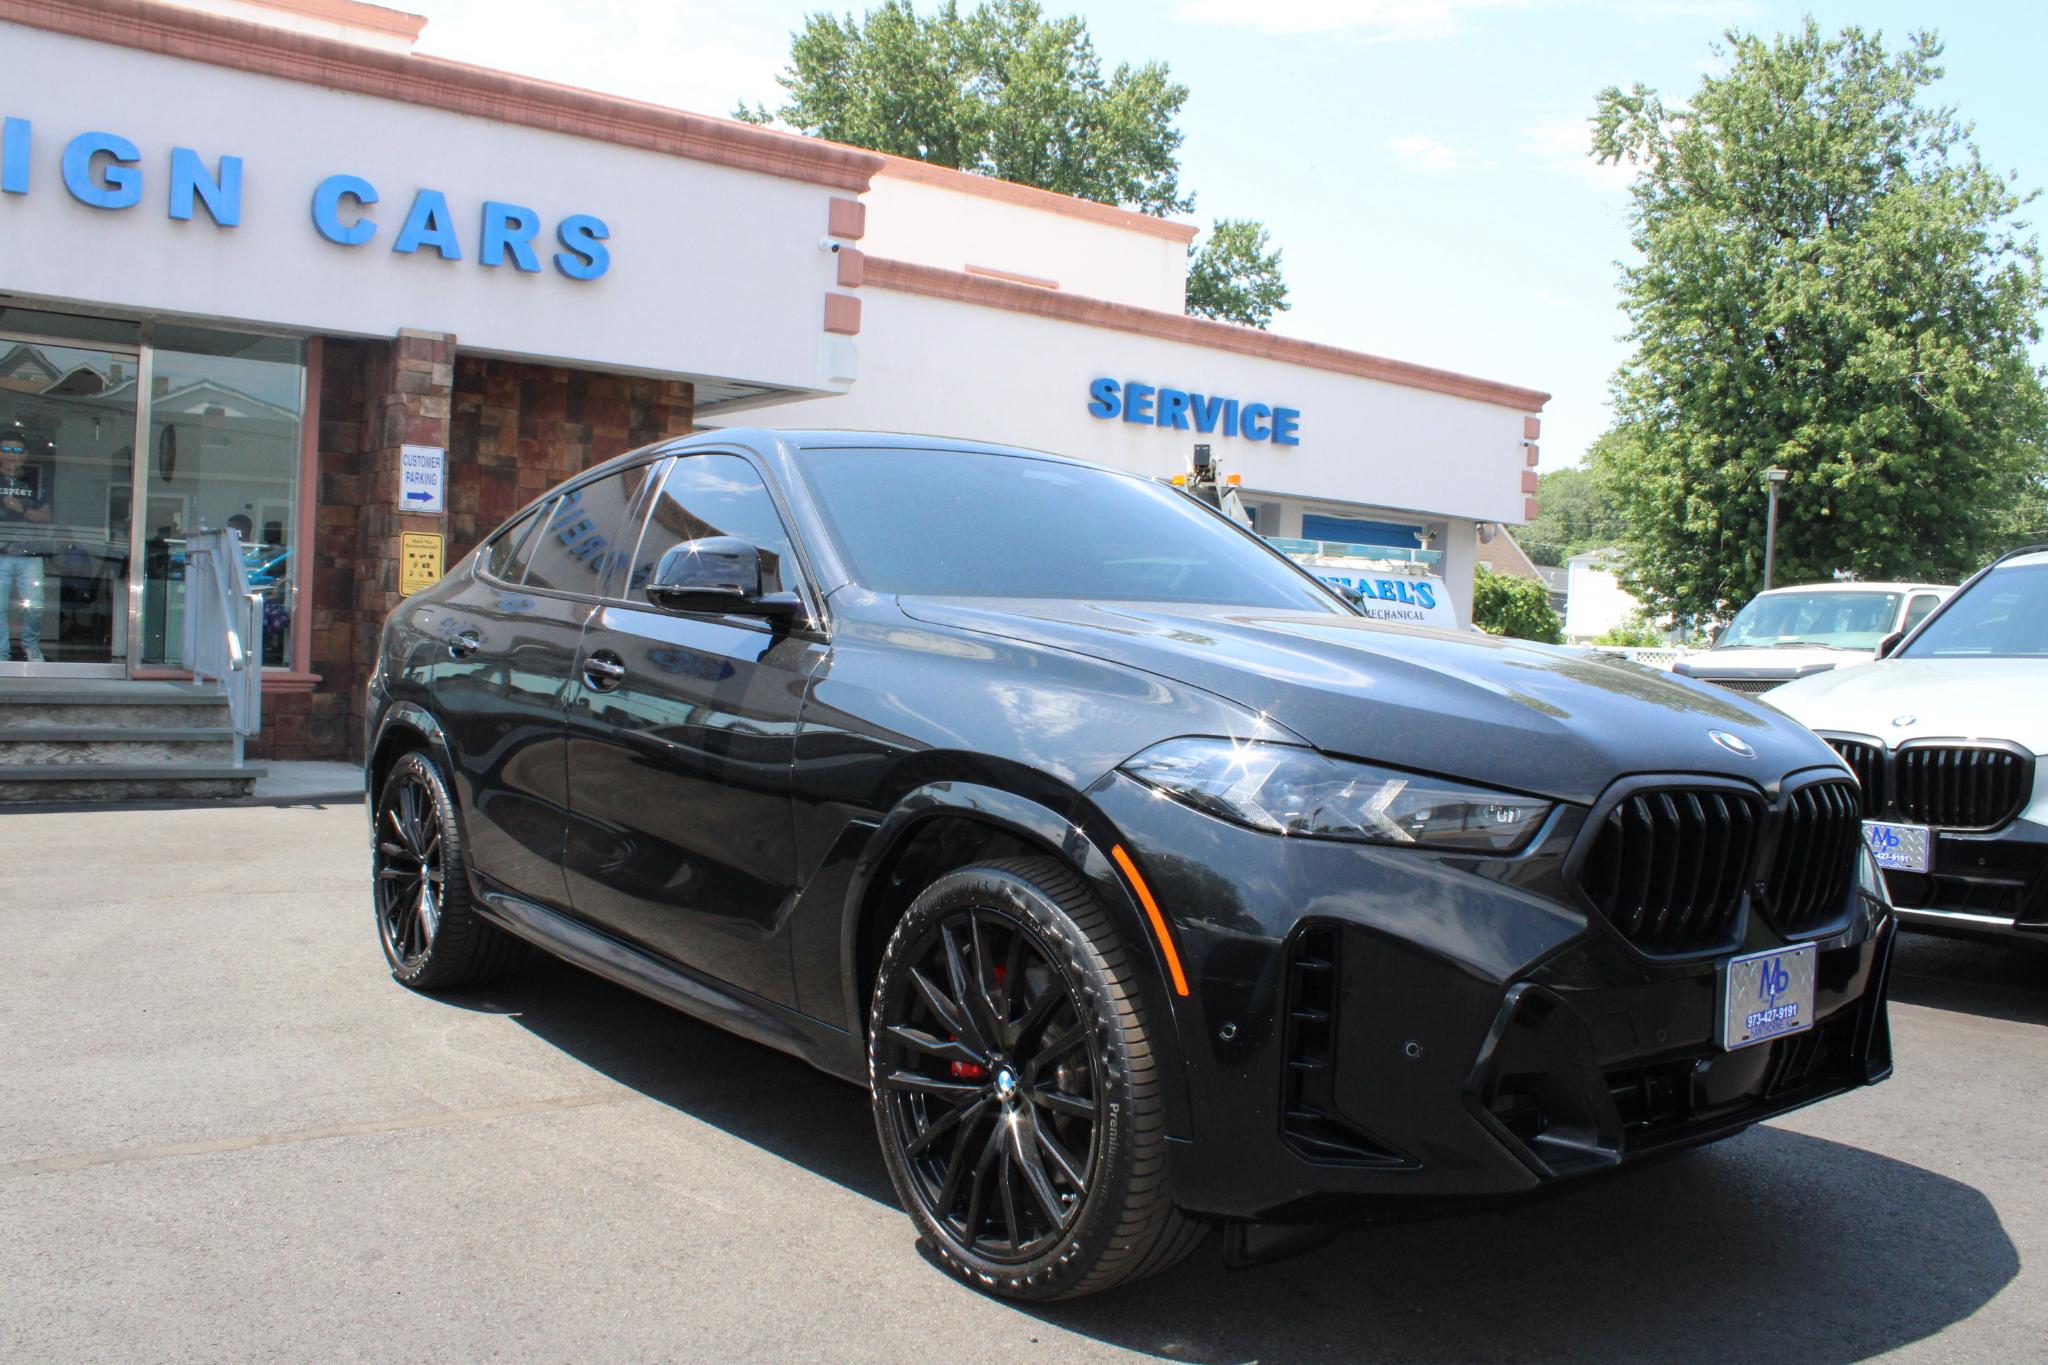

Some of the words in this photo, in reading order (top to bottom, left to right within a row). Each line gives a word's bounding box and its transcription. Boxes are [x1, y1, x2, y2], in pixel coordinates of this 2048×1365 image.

[2, 116, 242, 227] IGN
[310, 174, 610, 281] CARS
[1088, 377, 1300, 446] SERVICE
[403, 454, 440, 469] CUSTOMER
[406, 471, 437, 486] PARKING
[1318, 575, 1436, 609] AEL'S
[1747, 1004, 1797, 1028] 973-427-9191
